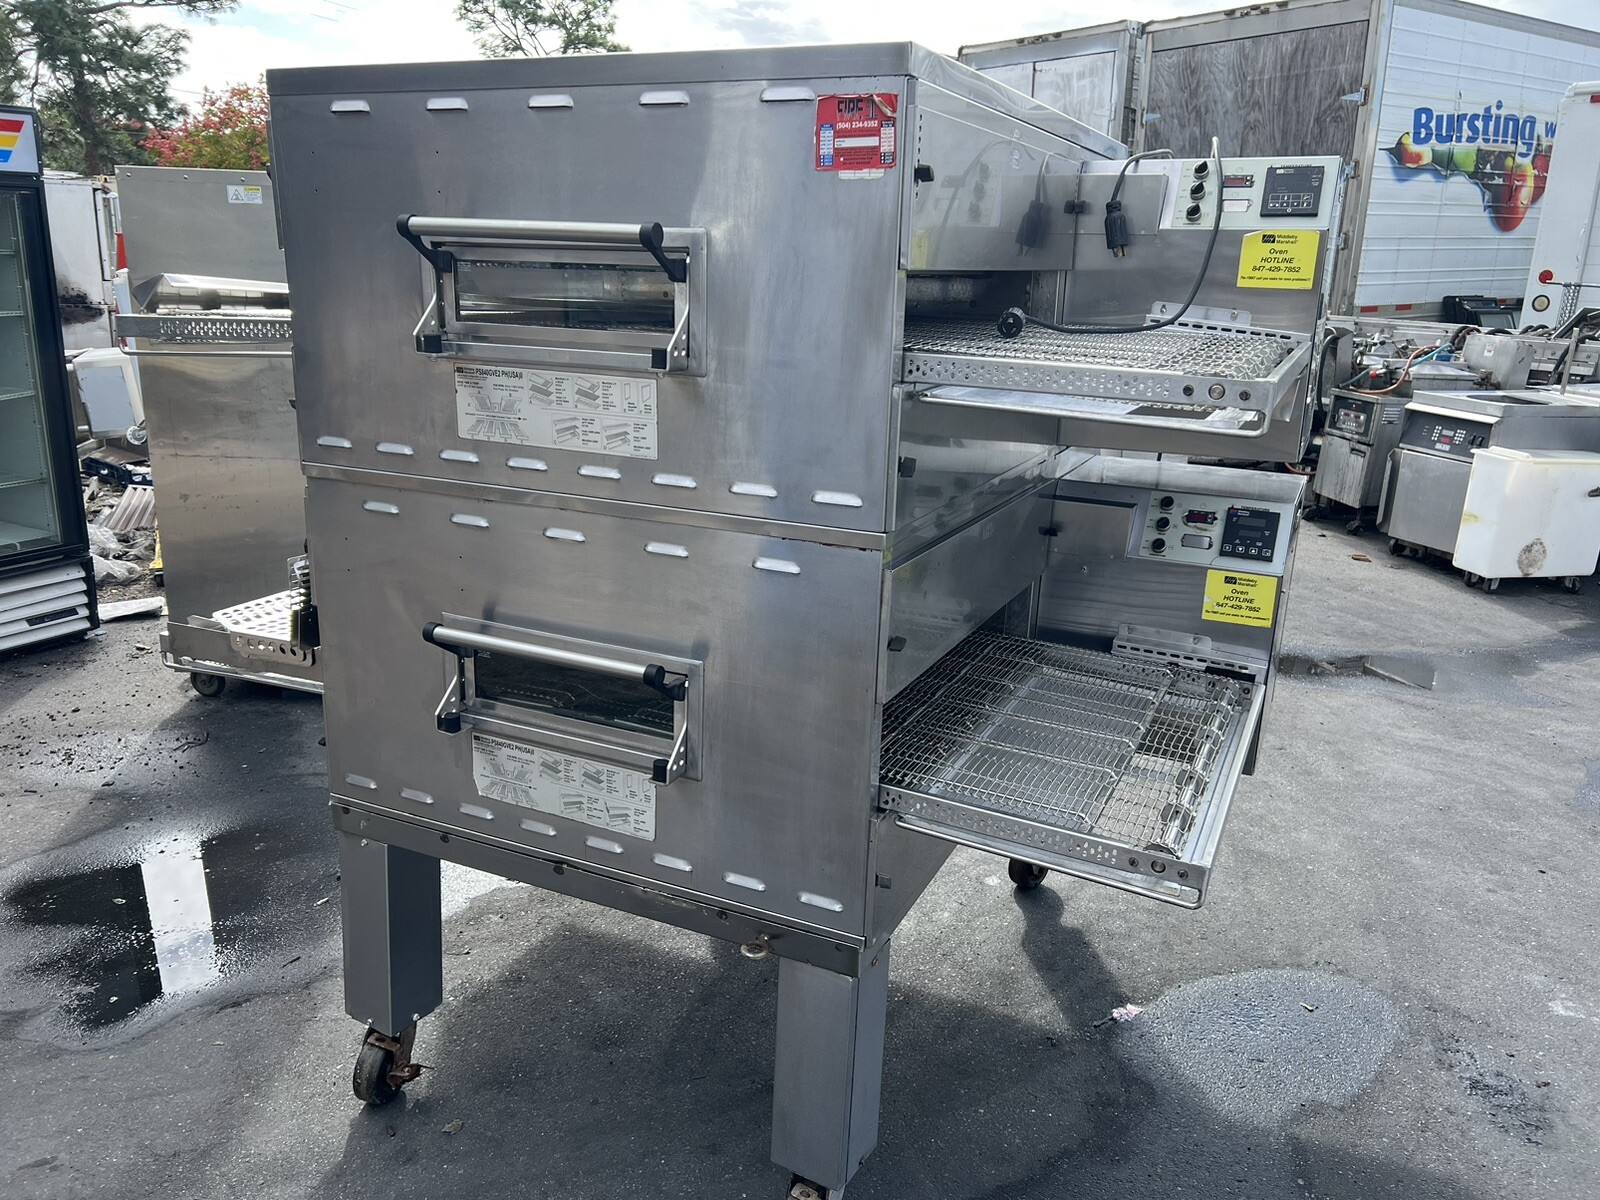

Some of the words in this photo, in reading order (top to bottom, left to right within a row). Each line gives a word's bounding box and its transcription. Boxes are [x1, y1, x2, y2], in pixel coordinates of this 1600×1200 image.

[836, 121, 851, 130] (504)
[852, 120, 879, 128] 234-9352
[1412, 99, 1537, 158] Bursting
[1223, 596, 1255, 604] HOTLINE
